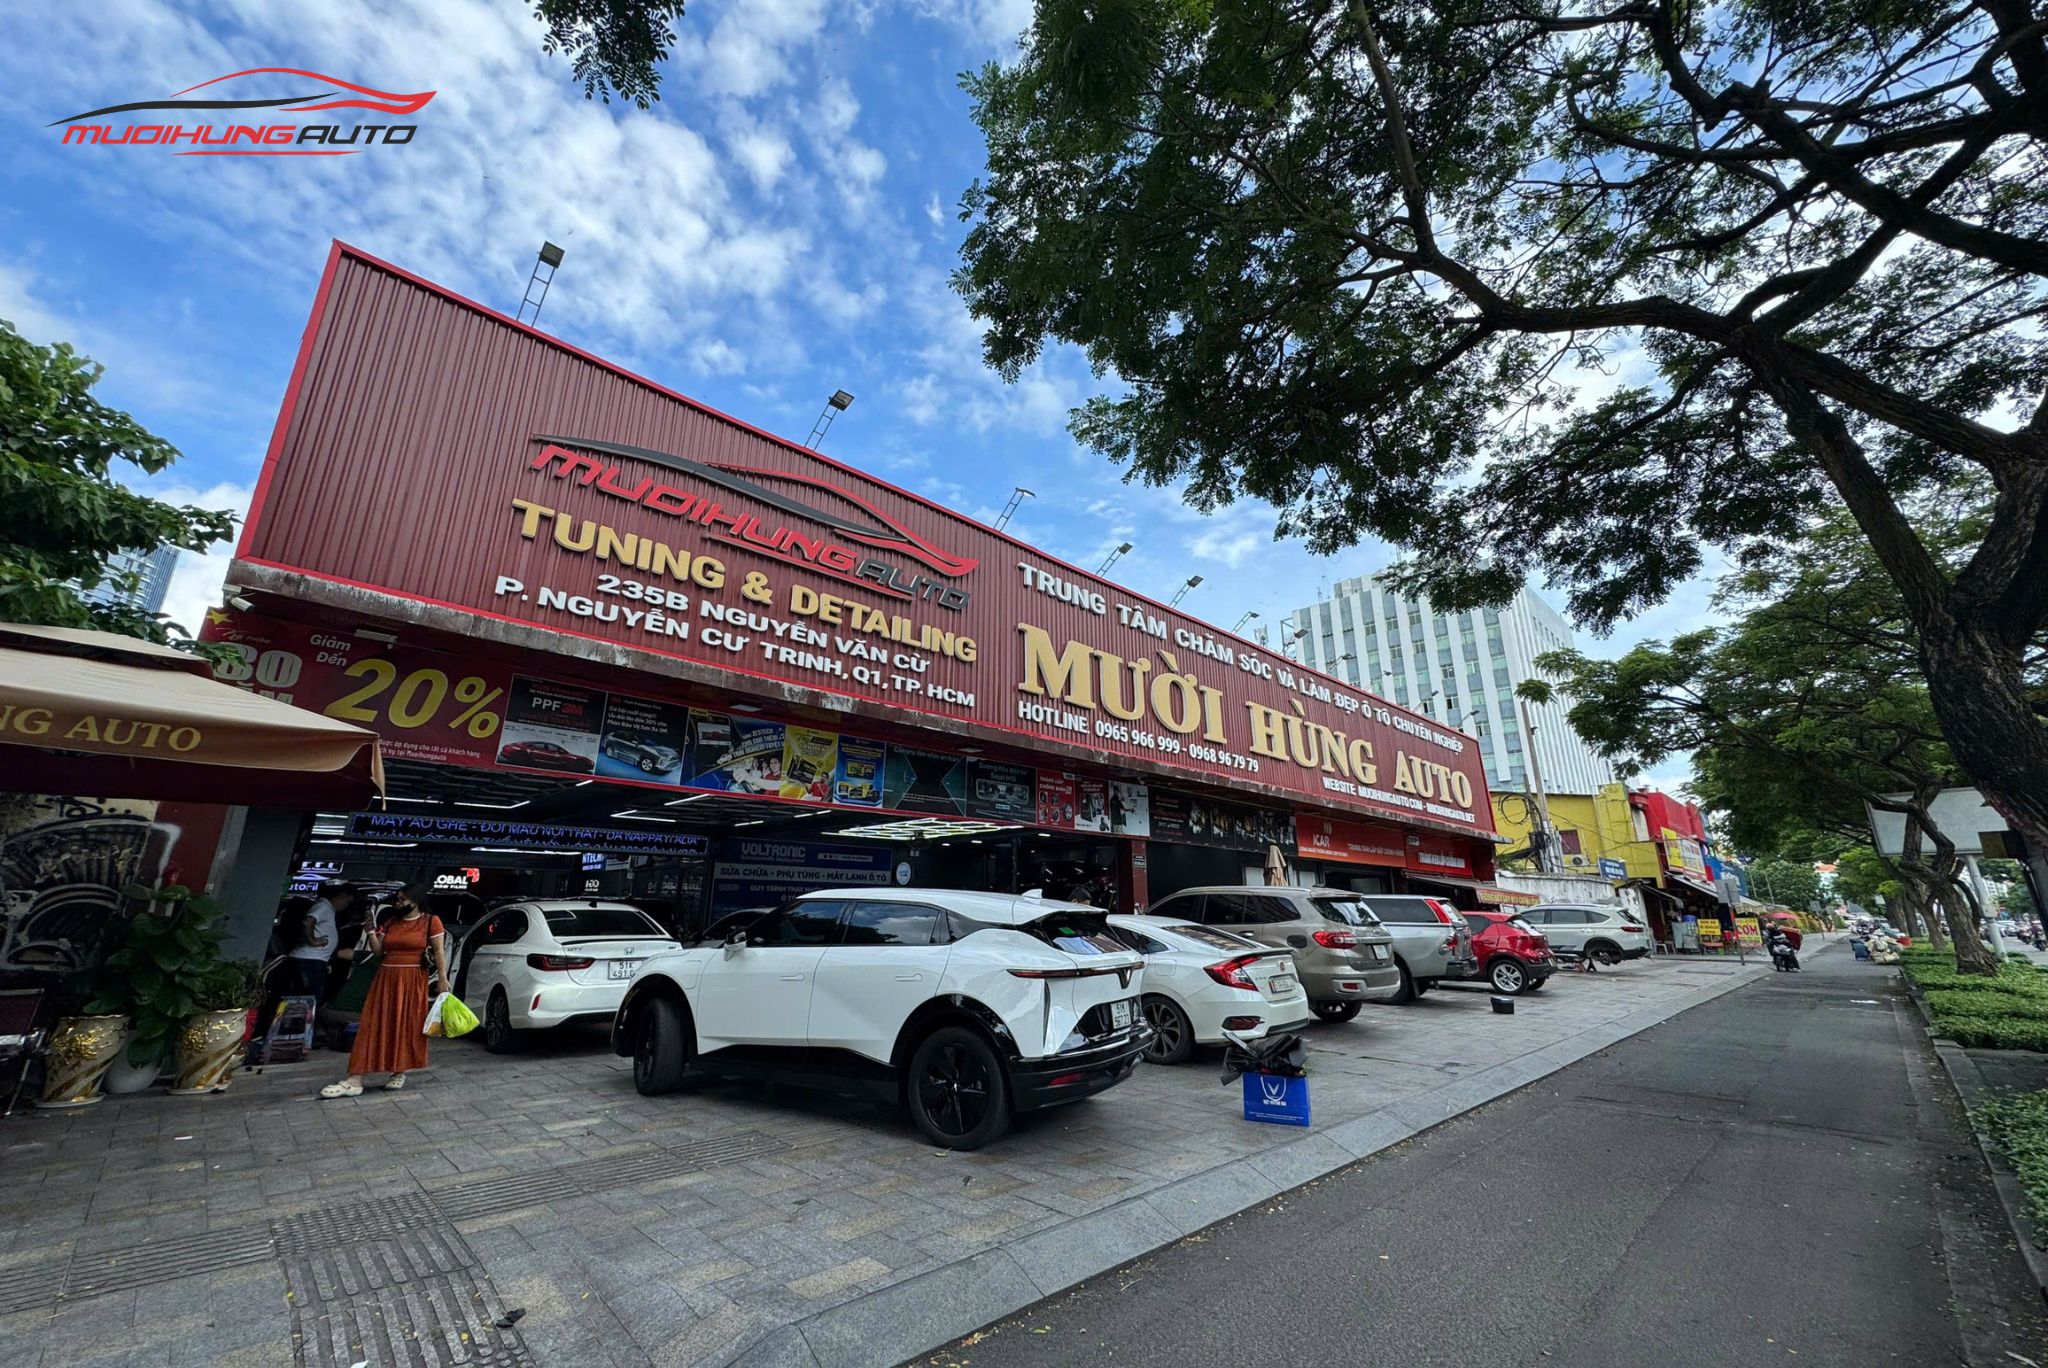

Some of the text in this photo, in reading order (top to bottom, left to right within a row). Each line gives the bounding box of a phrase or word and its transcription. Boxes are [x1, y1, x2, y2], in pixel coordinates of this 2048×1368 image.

[511, 498, 978, 663] TUNING & DETAILING
[310, 634, 351, 652] Giảm
[494, 575, 528, 601] P.
[537, 586, 690, 640] NGUYỄN
[701, 627, 750, 652] CƯ
[597, 574, 931, 673] 235B NGUYỄN VĂN CỪ
[316, 651, 348, 667] Đến
[1017, 562, 1106, 615] TRUNG
[1116, 603, 1168, 640] TÂM
[1174, 628, 1234, 665] CHĂM
[1238, 653, 1272, 680] SÓC
[1275, 666, 1297, 690] VÀ
[1300, 677, 1331, 704] LÀM
[1333, 692, 1360, 714] ĐẸP
[1361, 700, 1372, 719] Ô
[1374, 708, 1391, 726] TÔ
[1392, 716, 1433, 744] CHUYÊN
[323, 658, 504, 739] 20%
[531, 697, 562, 711] PPF
[1017, 623, 1473, 809] MƯỜI HÙNG AUTO
[64, 715, 202, 752] AUTO
[1095, 720, 1129, 743] 0965
[1131, 728, 1155, 749] 966
[1157, 735, 1180, 754] 999
[1189, 744, 1217, 763] 0968
[1218, 751, 1232, 766] 96
[1247, 757, 1259, 773] 79
[434, 875, 468, 885] OBAL
